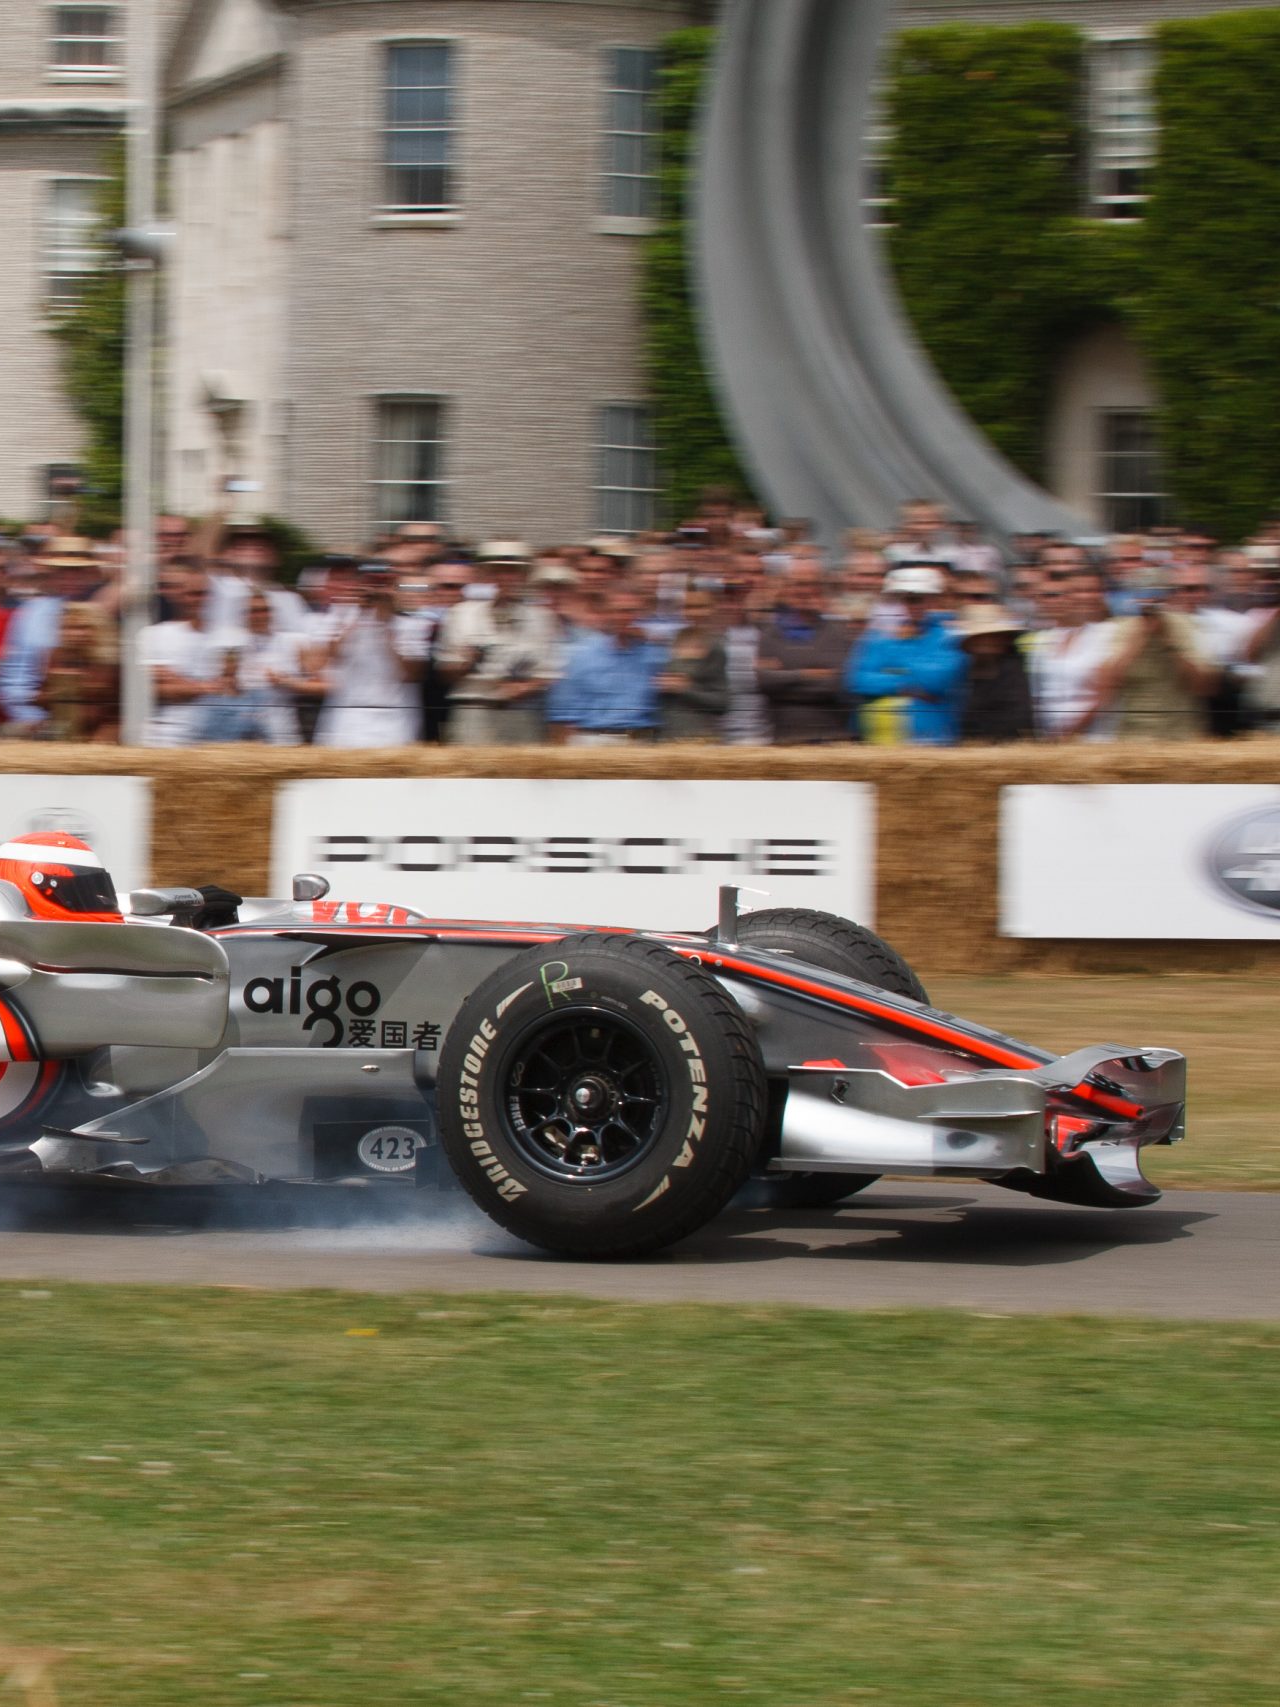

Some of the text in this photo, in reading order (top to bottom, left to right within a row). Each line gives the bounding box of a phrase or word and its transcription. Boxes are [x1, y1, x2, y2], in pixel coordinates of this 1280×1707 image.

[312, 835, 838, 876] PORSCHE
[243, 966, 381, 1048] aigo
[348, 1018, 442, 1051] 爱国者
[639, 989, 708, 1167] POTENZA
[459, 1018, 529, 1202] BRIDGESTONE
[370, 1136, 415, 1160] 423
